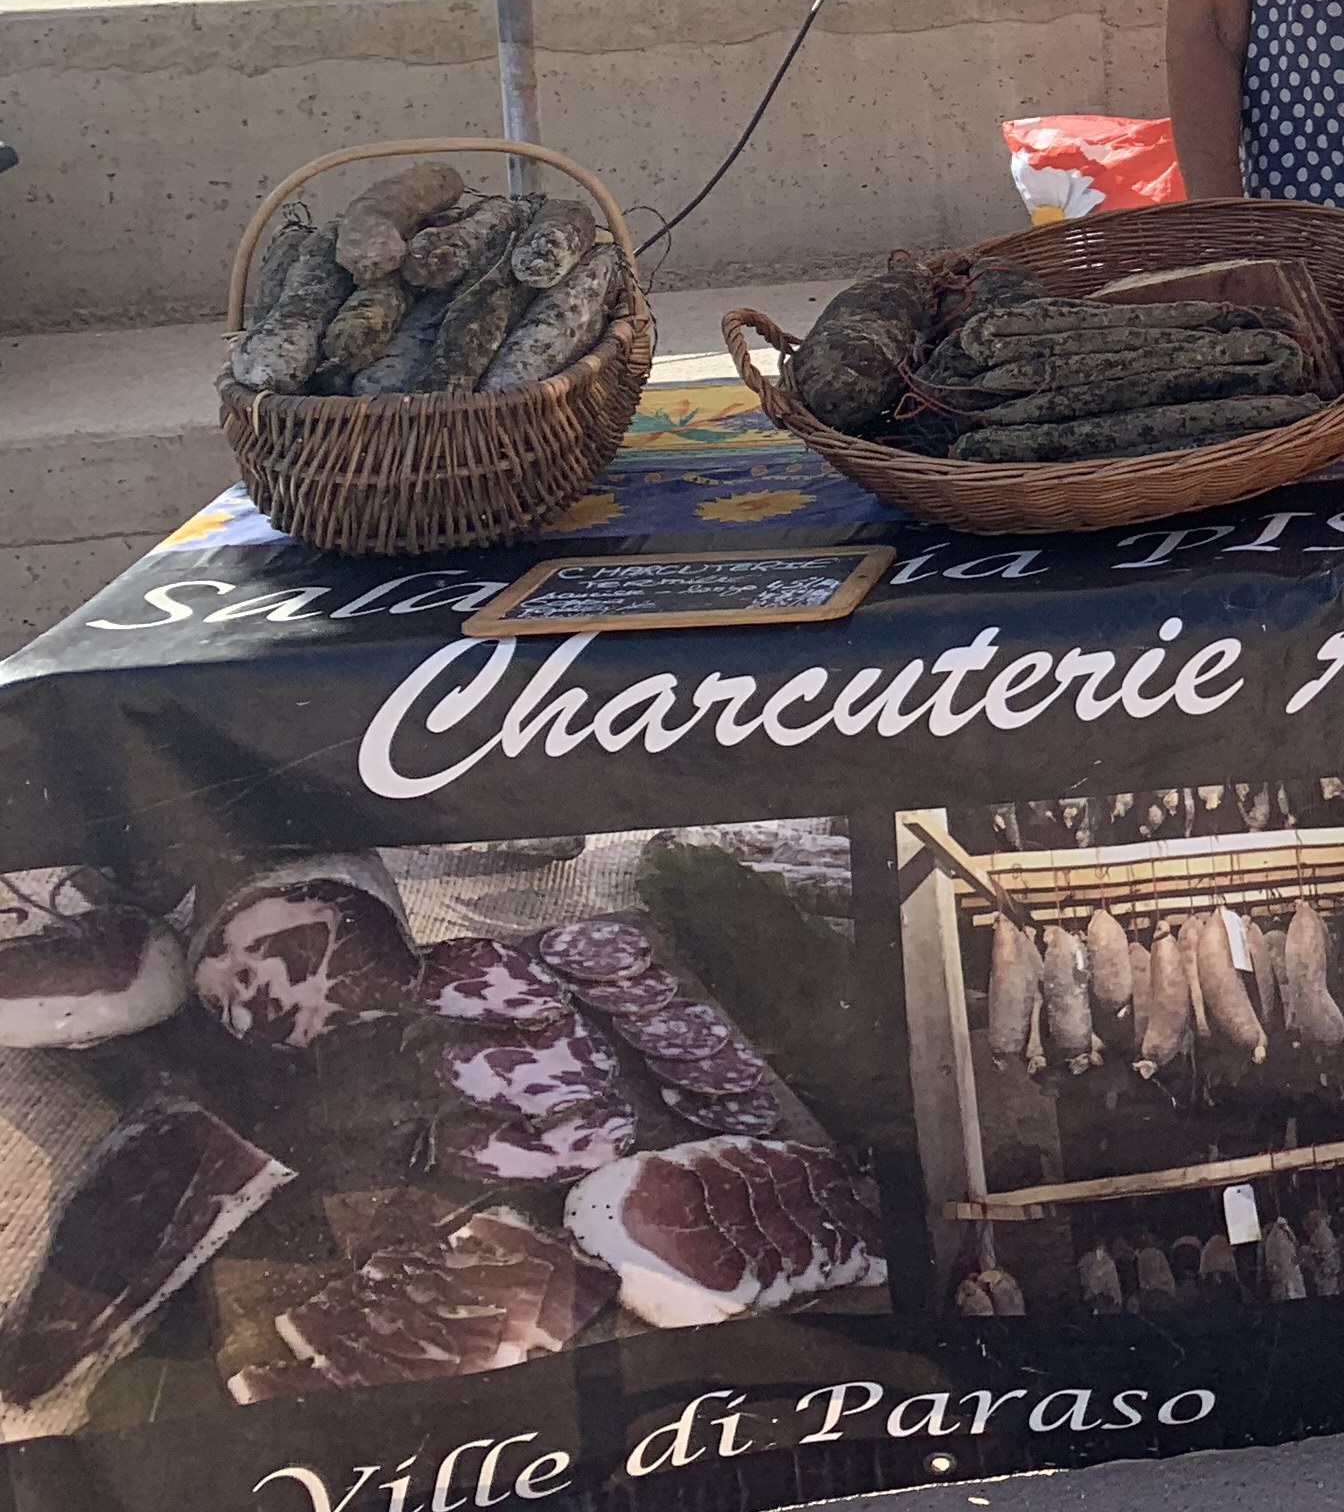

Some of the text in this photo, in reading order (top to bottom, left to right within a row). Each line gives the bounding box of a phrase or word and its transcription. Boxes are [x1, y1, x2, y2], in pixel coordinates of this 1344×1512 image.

[556, 556, 839, 580] CHARCUTERIE
[359, 616, 1244, 799] Charcuterie
[252, 1379, 1217, 1512] Ville di Paraso
